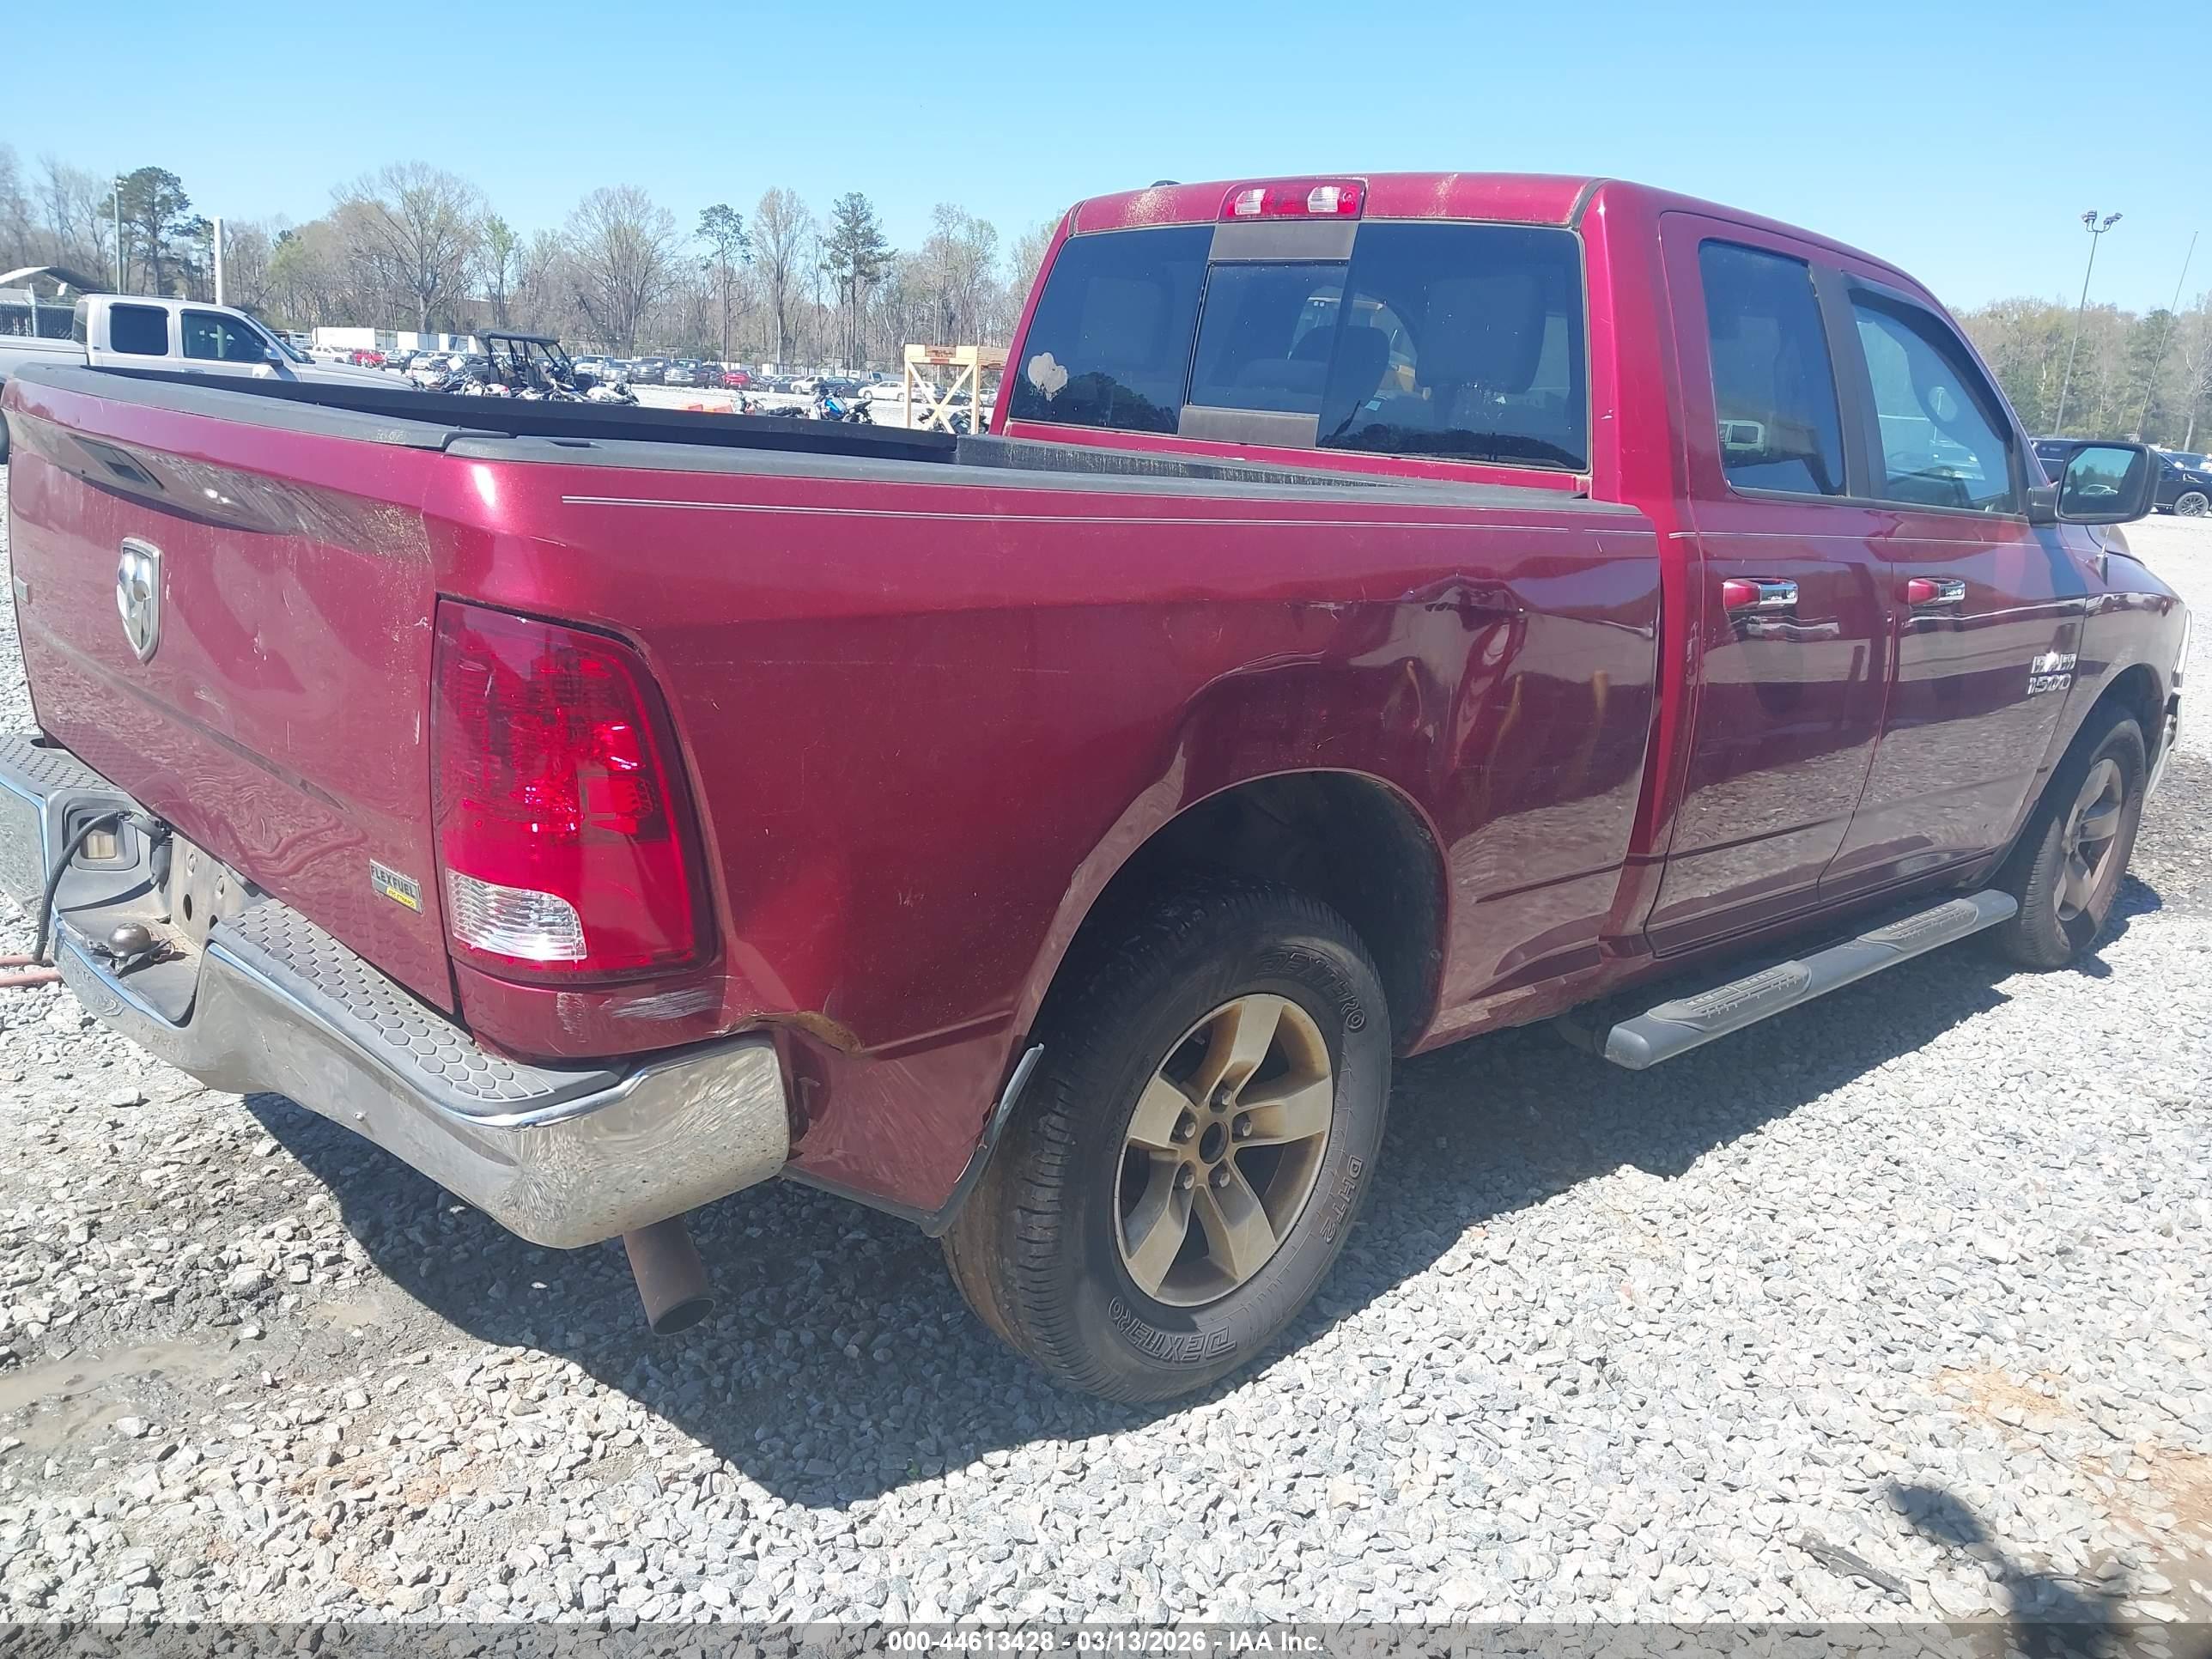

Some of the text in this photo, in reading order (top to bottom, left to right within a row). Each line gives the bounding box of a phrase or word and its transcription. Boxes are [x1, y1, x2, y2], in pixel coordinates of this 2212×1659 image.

[2027, 673, 2072, 695] 1500
[370, 864, 416, 900] FLEXFUEL
[1320, 1154, 1364, 1245] DHT2
